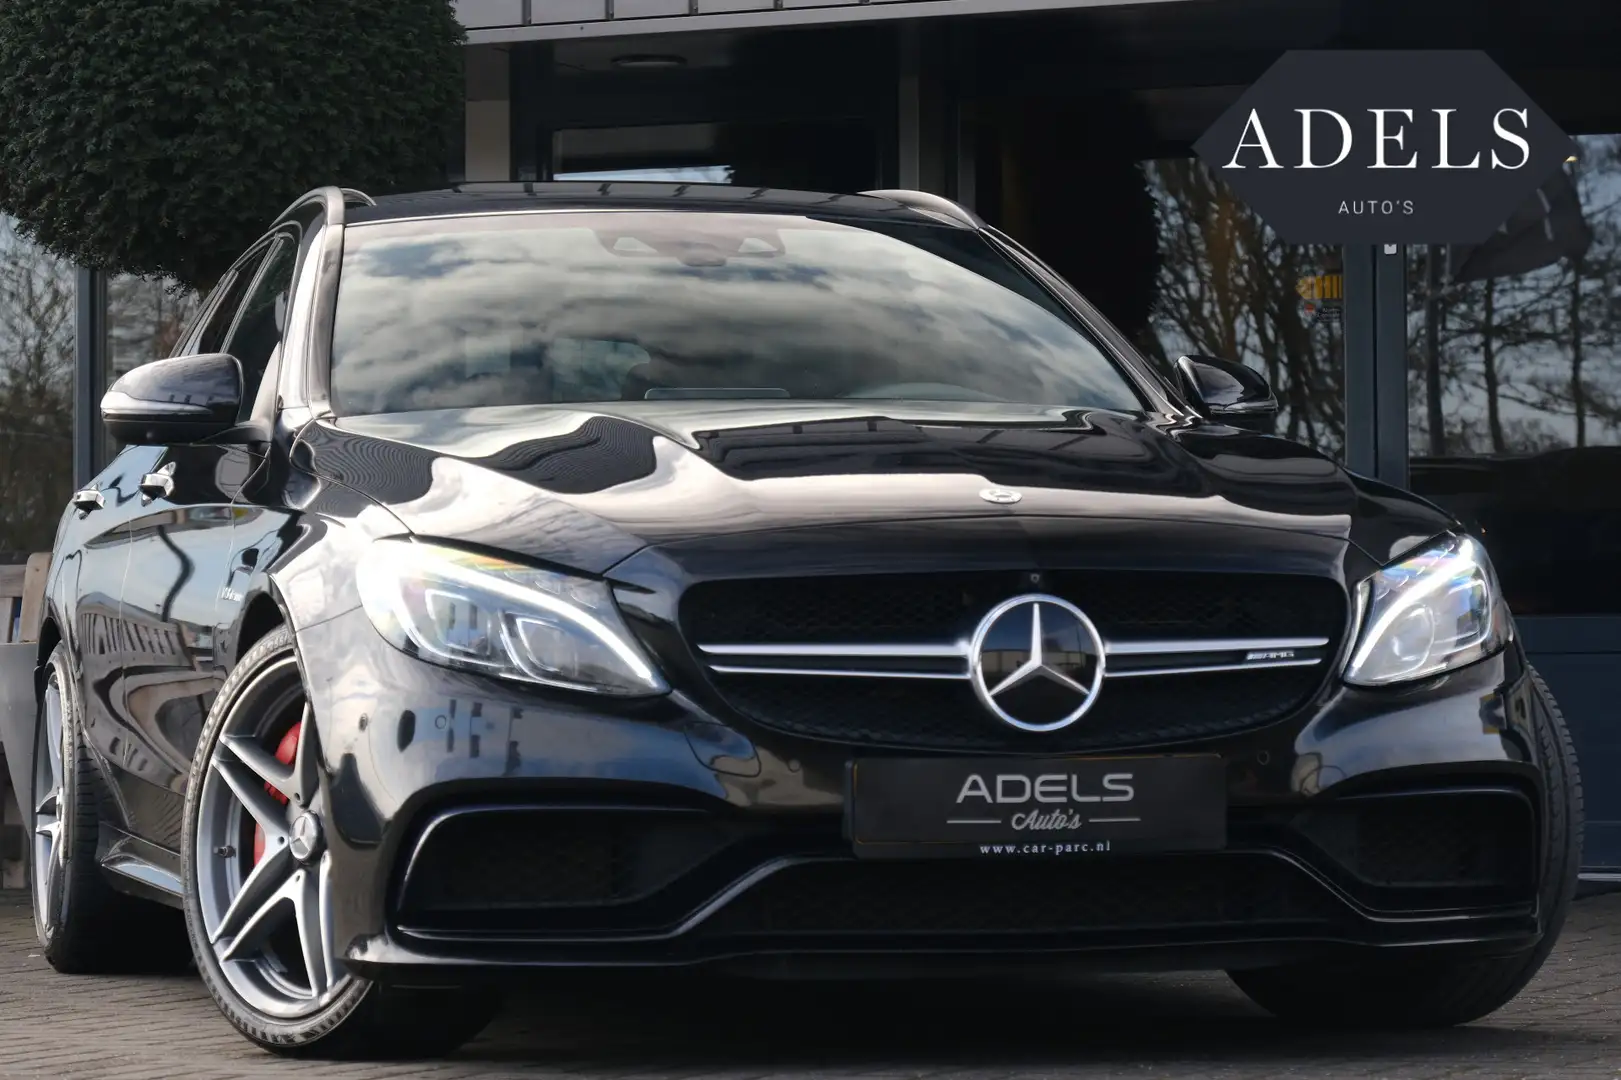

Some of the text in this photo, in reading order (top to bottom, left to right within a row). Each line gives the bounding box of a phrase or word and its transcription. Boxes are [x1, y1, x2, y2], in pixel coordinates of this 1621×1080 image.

[955, 773, 1135, 804] ADELS
[1011, 808, 1082, 830] Auto's
[980, 840, 1111, 856] www.car-parc.nl
